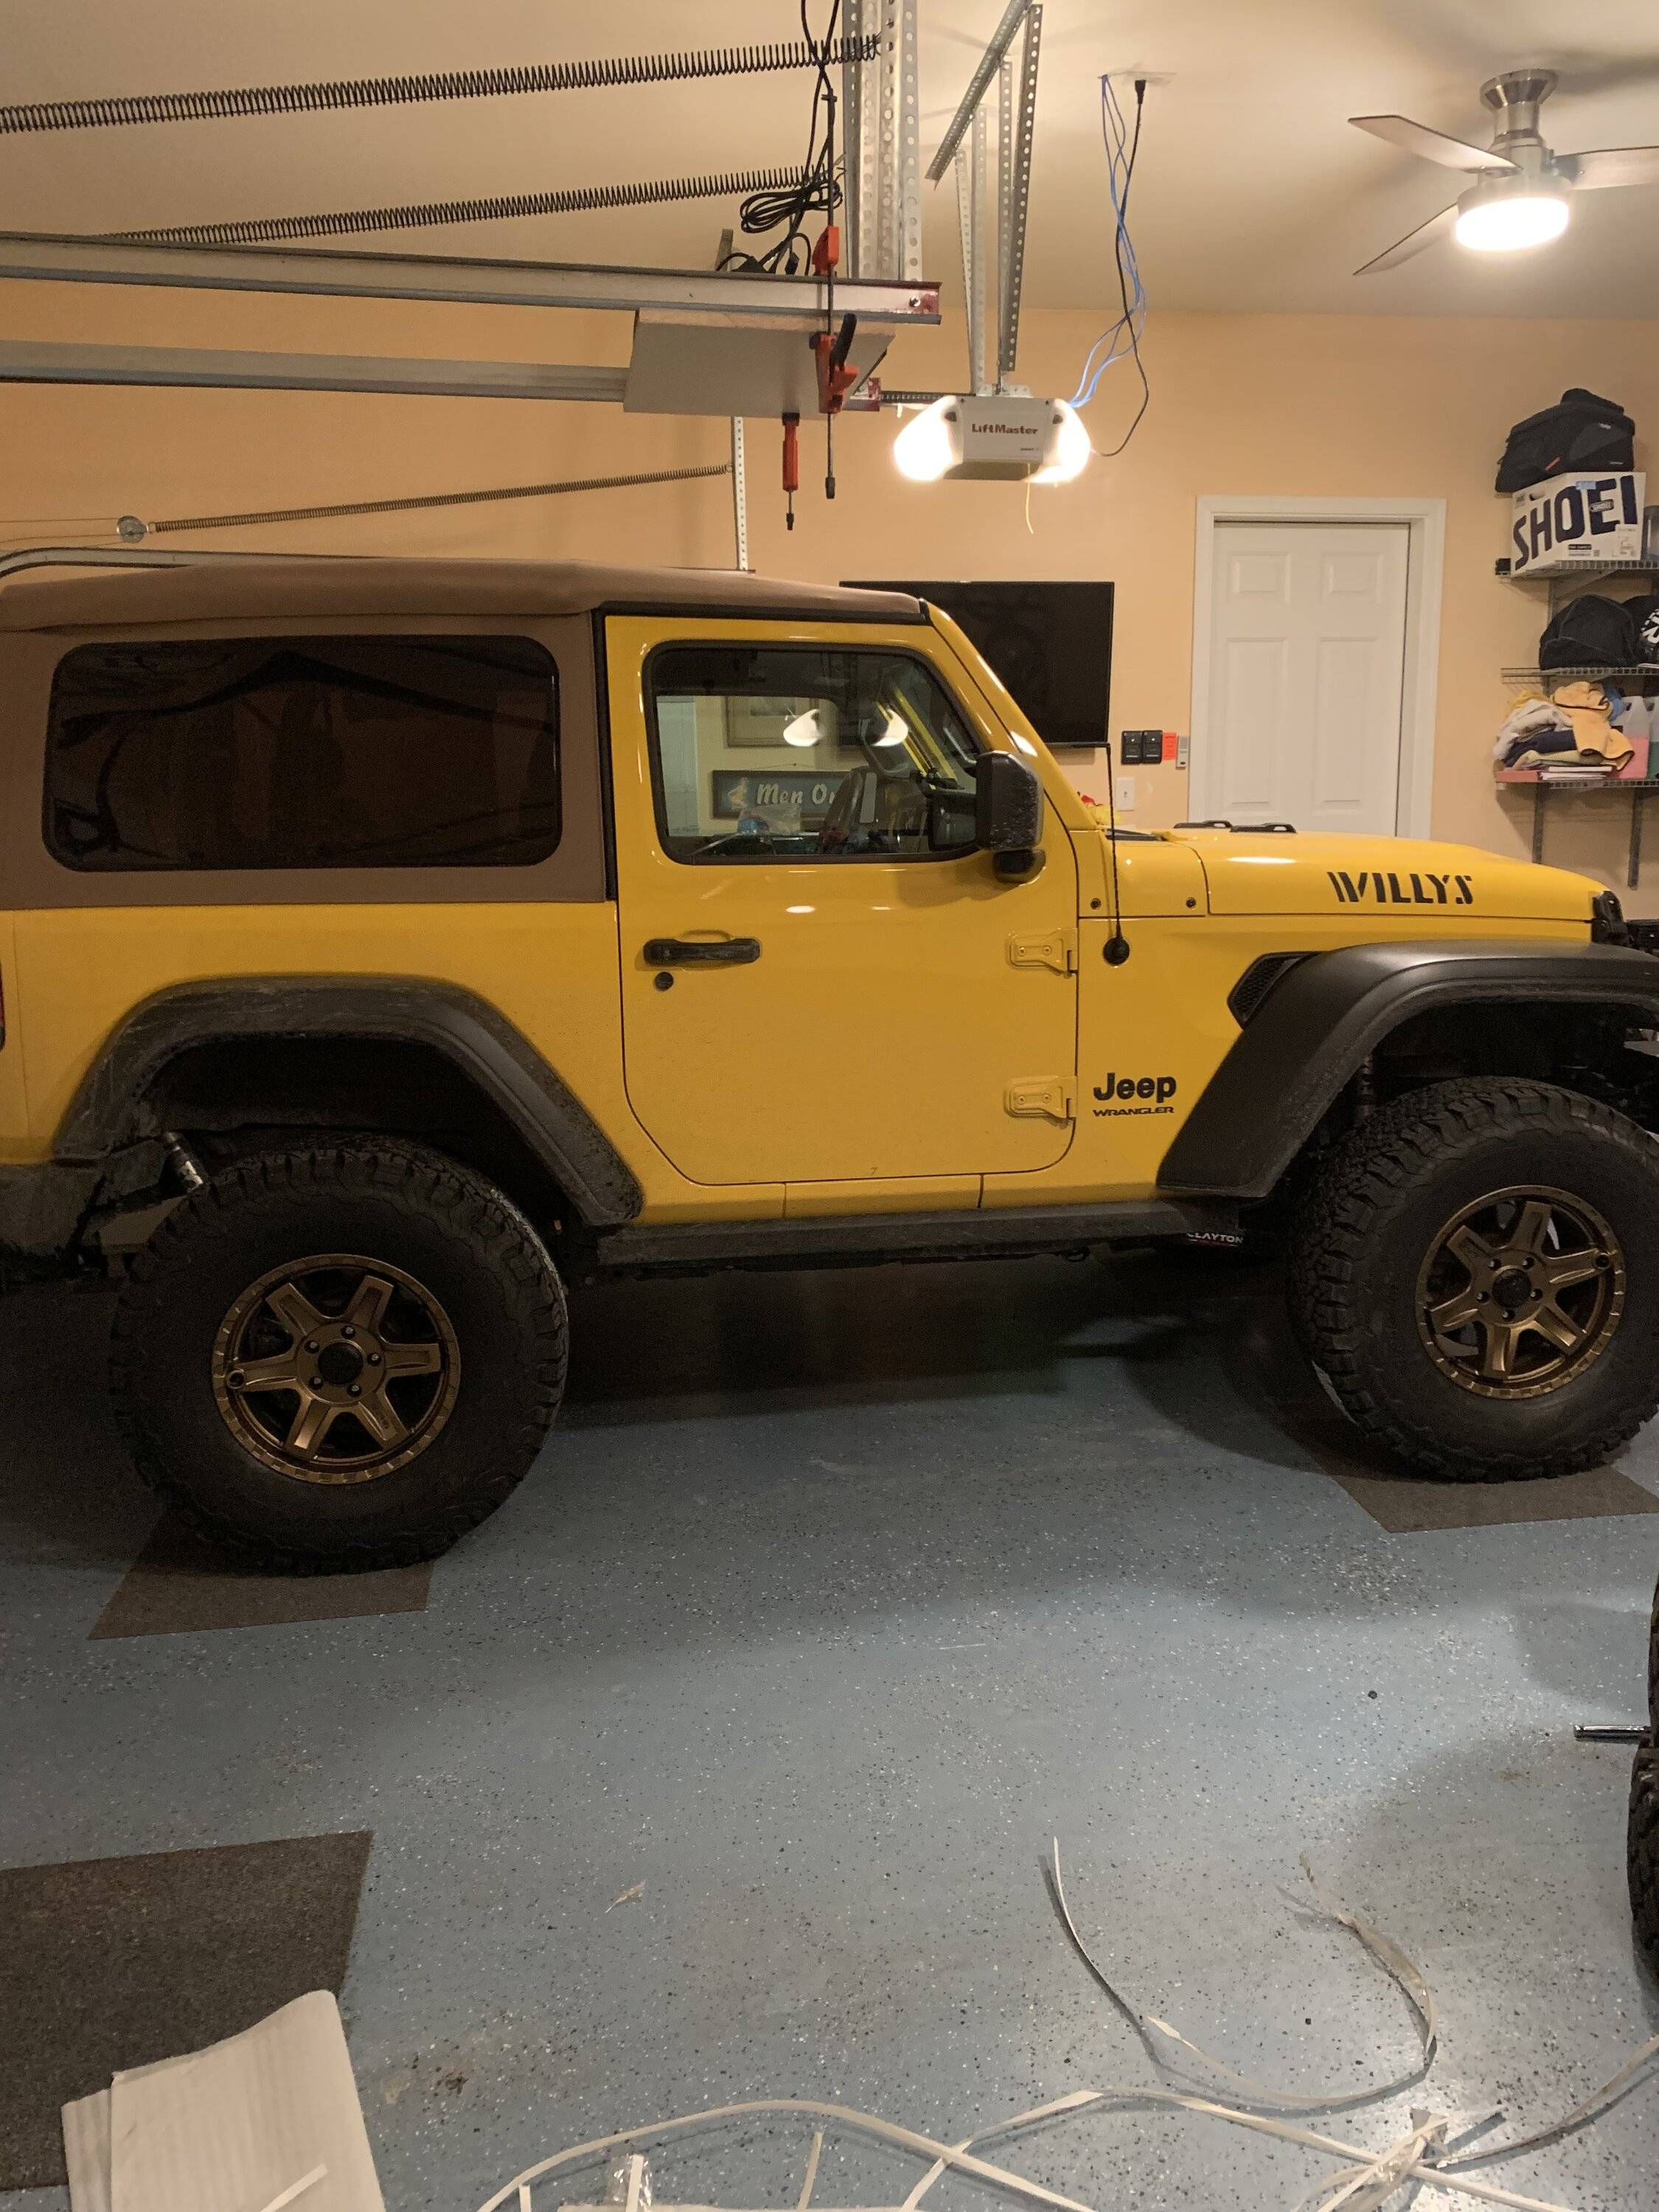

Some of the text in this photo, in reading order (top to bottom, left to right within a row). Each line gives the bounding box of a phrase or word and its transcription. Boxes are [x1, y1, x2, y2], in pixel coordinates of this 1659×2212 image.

[972, 423, 1038, 435] LiftMaster
[1513, 475, 1638, 571] SHOEI
[757, 783, 804, 804] Men
[1326, 872, 1474, 905] WILLYS
[1093, 1072, 1177, 1103] Jeep
[1093, 1106, 1175, 1117] WRANGLER
